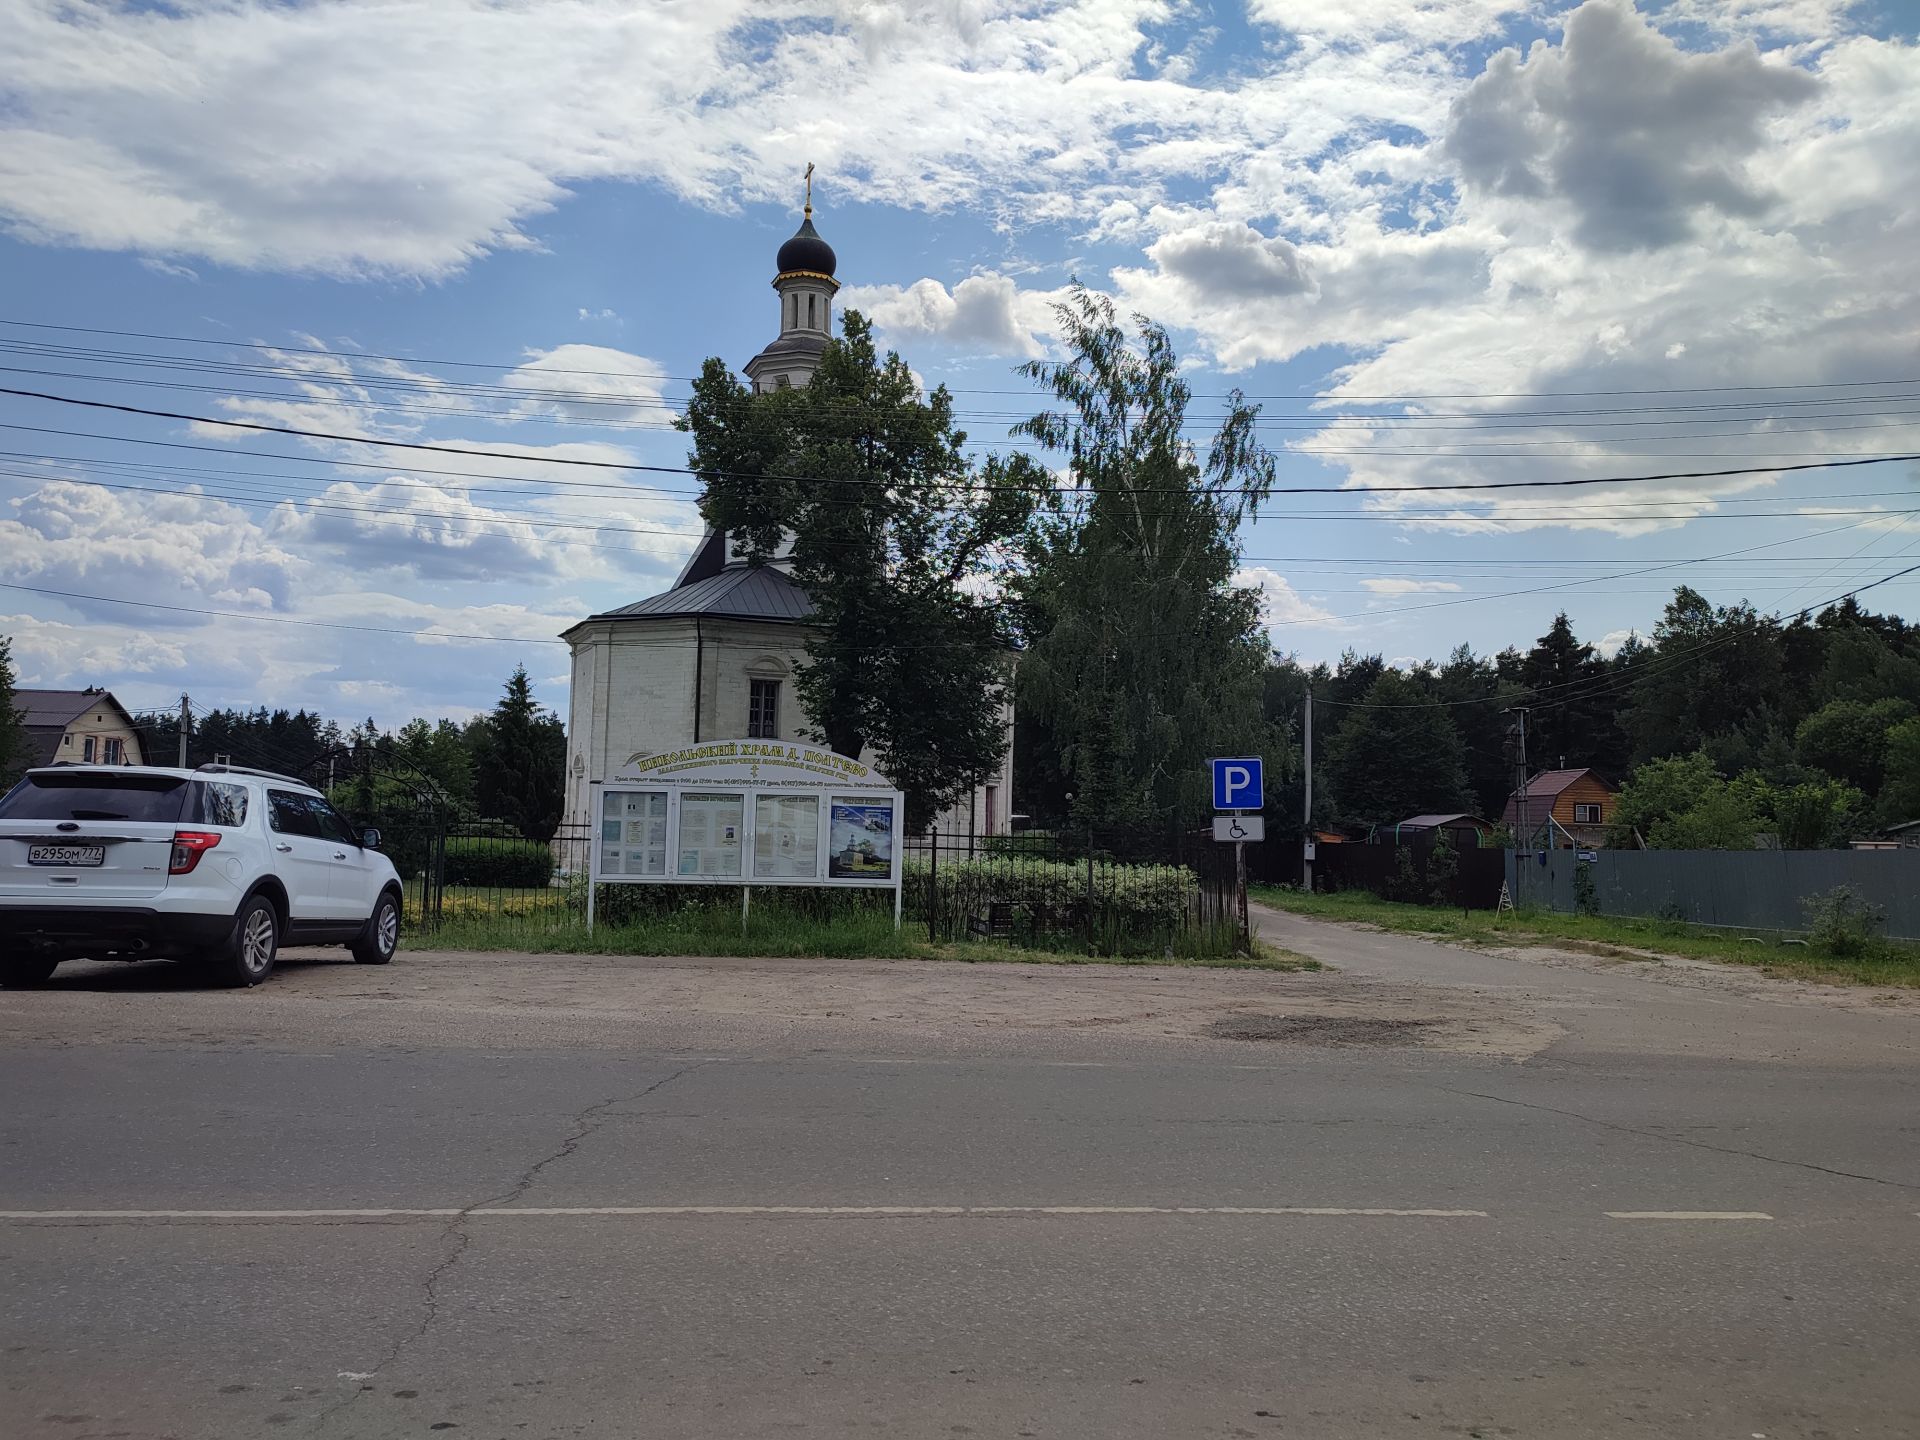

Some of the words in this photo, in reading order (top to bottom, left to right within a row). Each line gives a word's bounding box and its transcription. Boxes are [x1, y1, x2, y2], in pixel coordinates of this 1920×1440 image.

[637, 742, 737, 773] НИКОЛЬСКИЙ
[740, 744, 784, 758] ХРАМ
[786, 747, 800, 761] Д.
[802, 749, 869, 777] ПОЛТЕВО
[1225, 767, 1251, 804] P
[34, 847, 79, 860] В295ОМ
[82, 847, 99, 857] 777
